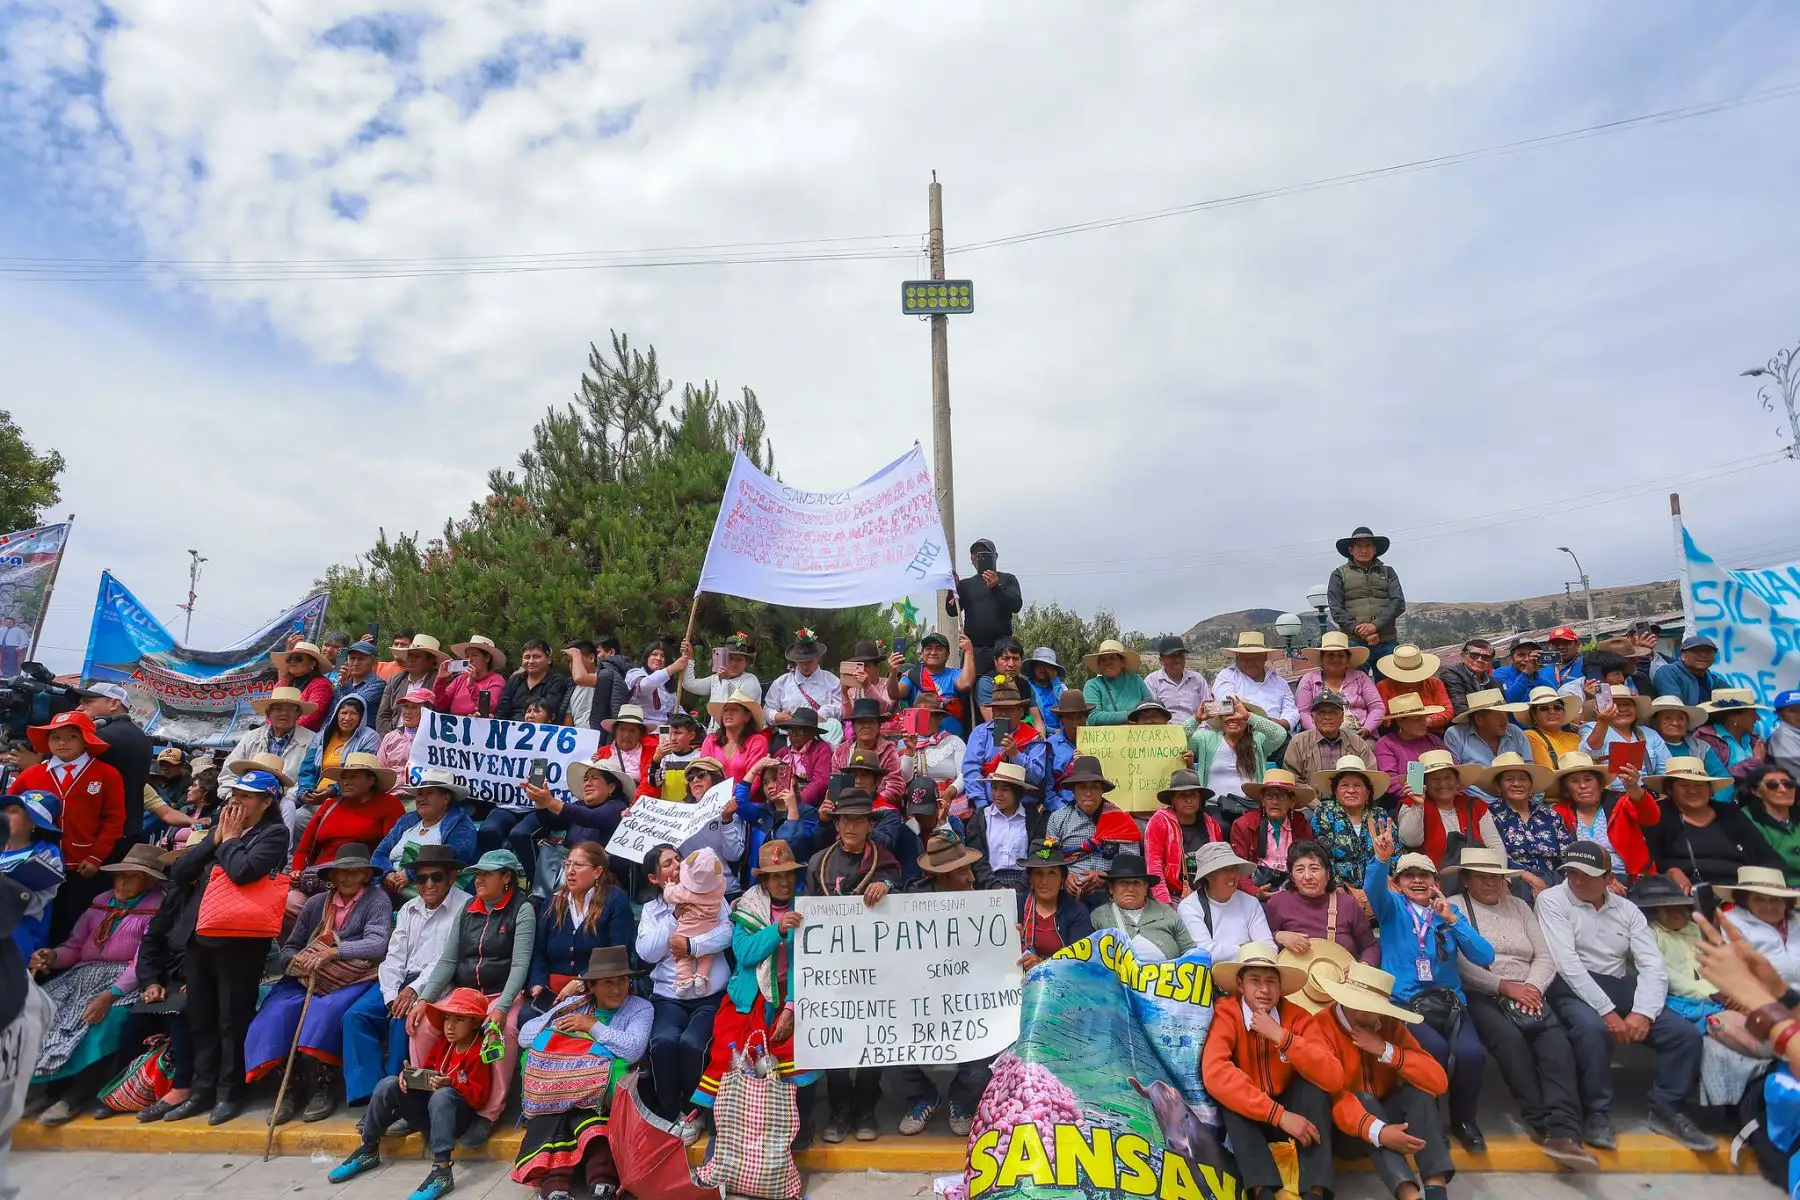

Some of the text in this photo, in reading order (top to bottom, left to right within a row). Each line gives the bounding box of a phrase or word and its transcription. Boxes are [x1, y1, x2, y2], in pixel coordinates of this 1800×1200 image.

[906, 538, 941, 580] JERI
[1081, 729, 1172, 743] ANEXO AYCARA
[1090, 747, 1113, 759] PIDE
[428, 745, 562, 784] BIENVENIO
[1128, 763, 1143, 776] DE
[1128, 780, 1134, 792] Y
[622, 818, 637, 830] de
[612, 831, 645, 852] de la
[803, 896, 1002, 918] COMUNIDAD CAMPESINA DE
[802, 913, 1008, 956] CALPAMAYO
[801, 958, 970, 988] PRESENTE SEÑOR
[798, 997, 898, 1021] PRESIDENTE
[911, 997, 931, 1017] TE
[808, 1018, 989, 1048] CON LOS BRAZOS
[859, 1044, 958, 1065] ABIERTOS
